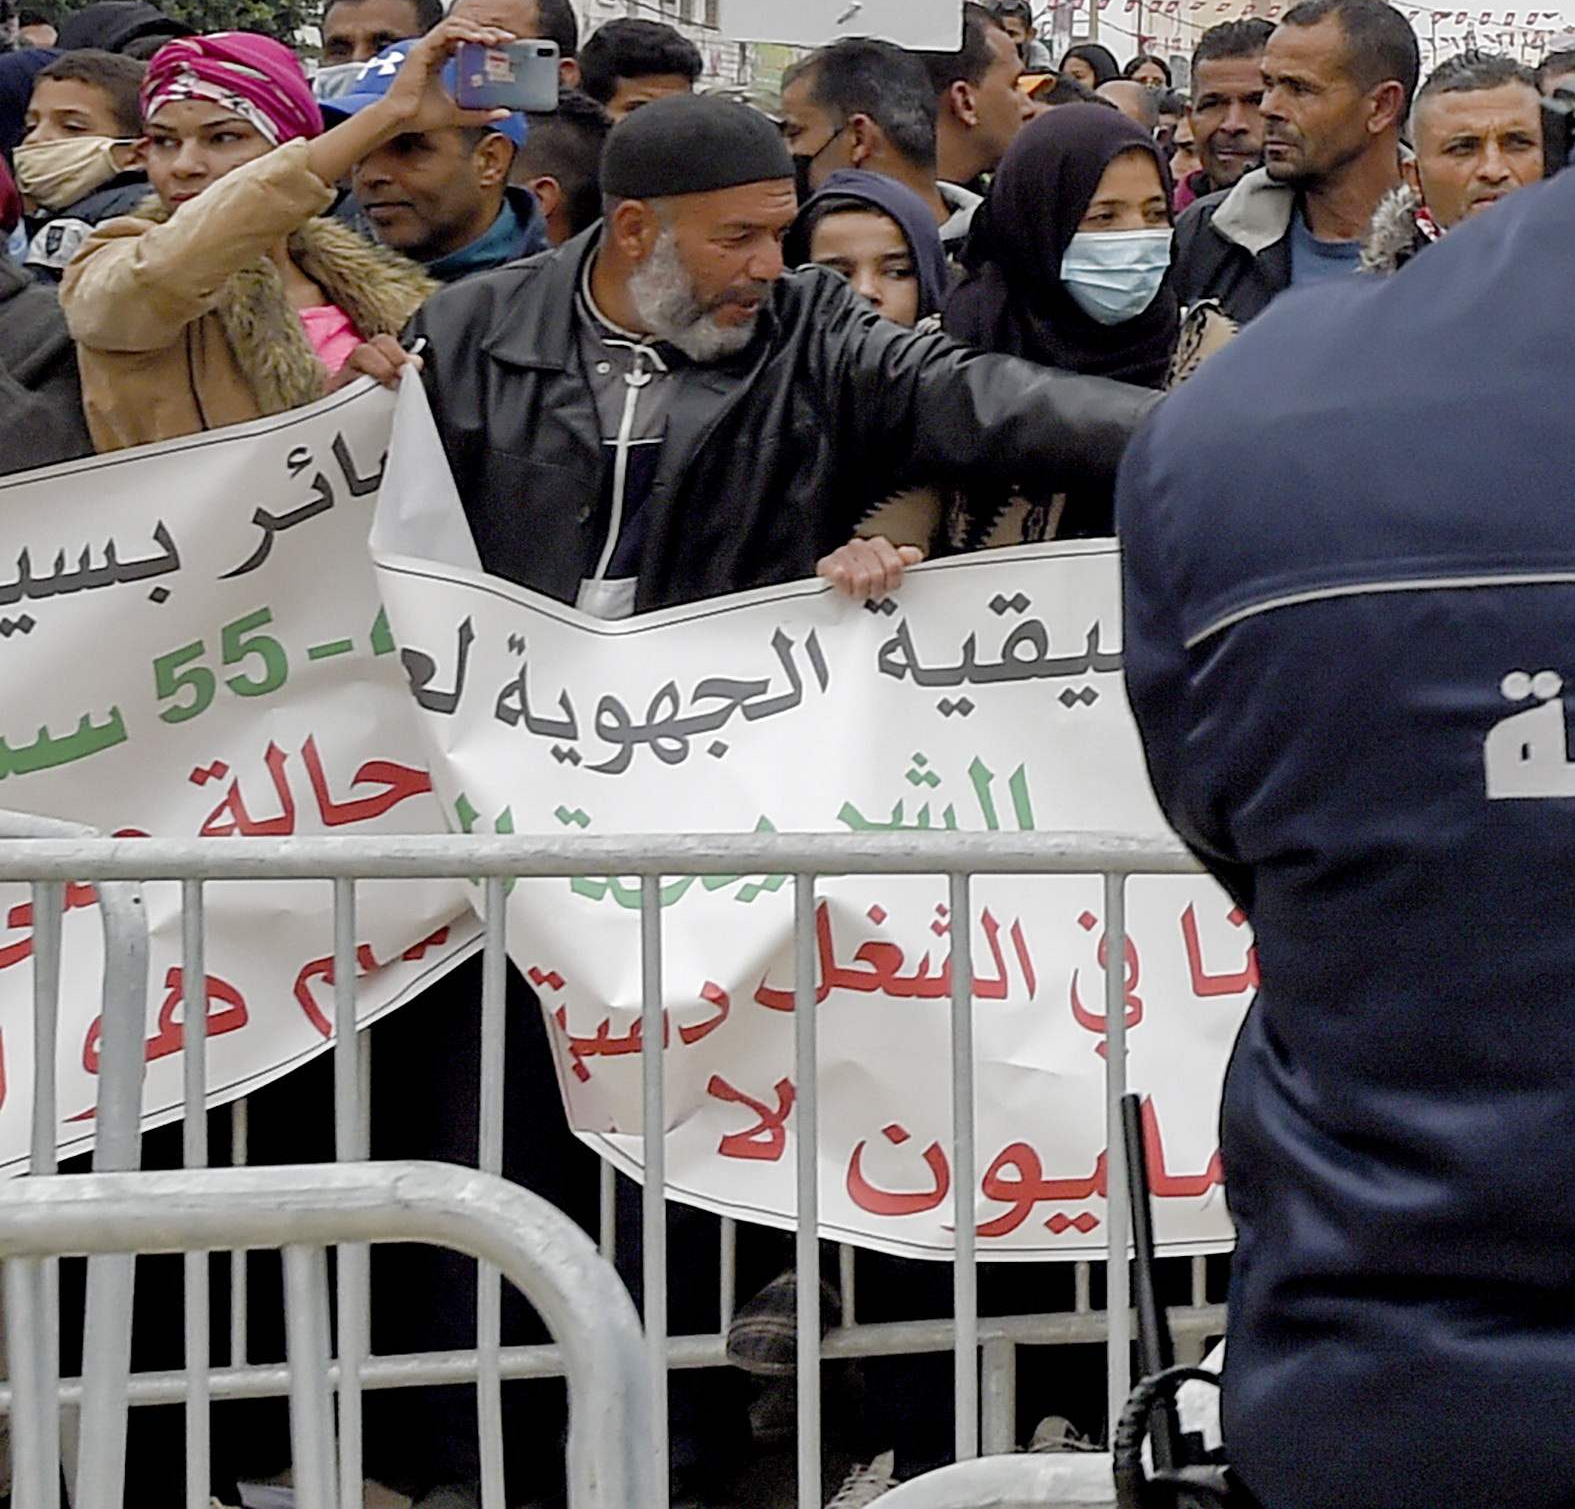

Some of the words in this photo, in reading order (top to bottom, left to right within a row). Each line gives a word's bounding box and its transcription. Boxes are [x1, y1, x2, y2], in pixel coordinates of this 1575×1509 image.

[494, 623, 829, 775] الجهوية
[754, 901, 1037, 1012] الشغل
[707, 1074, 797, 1162] لا
